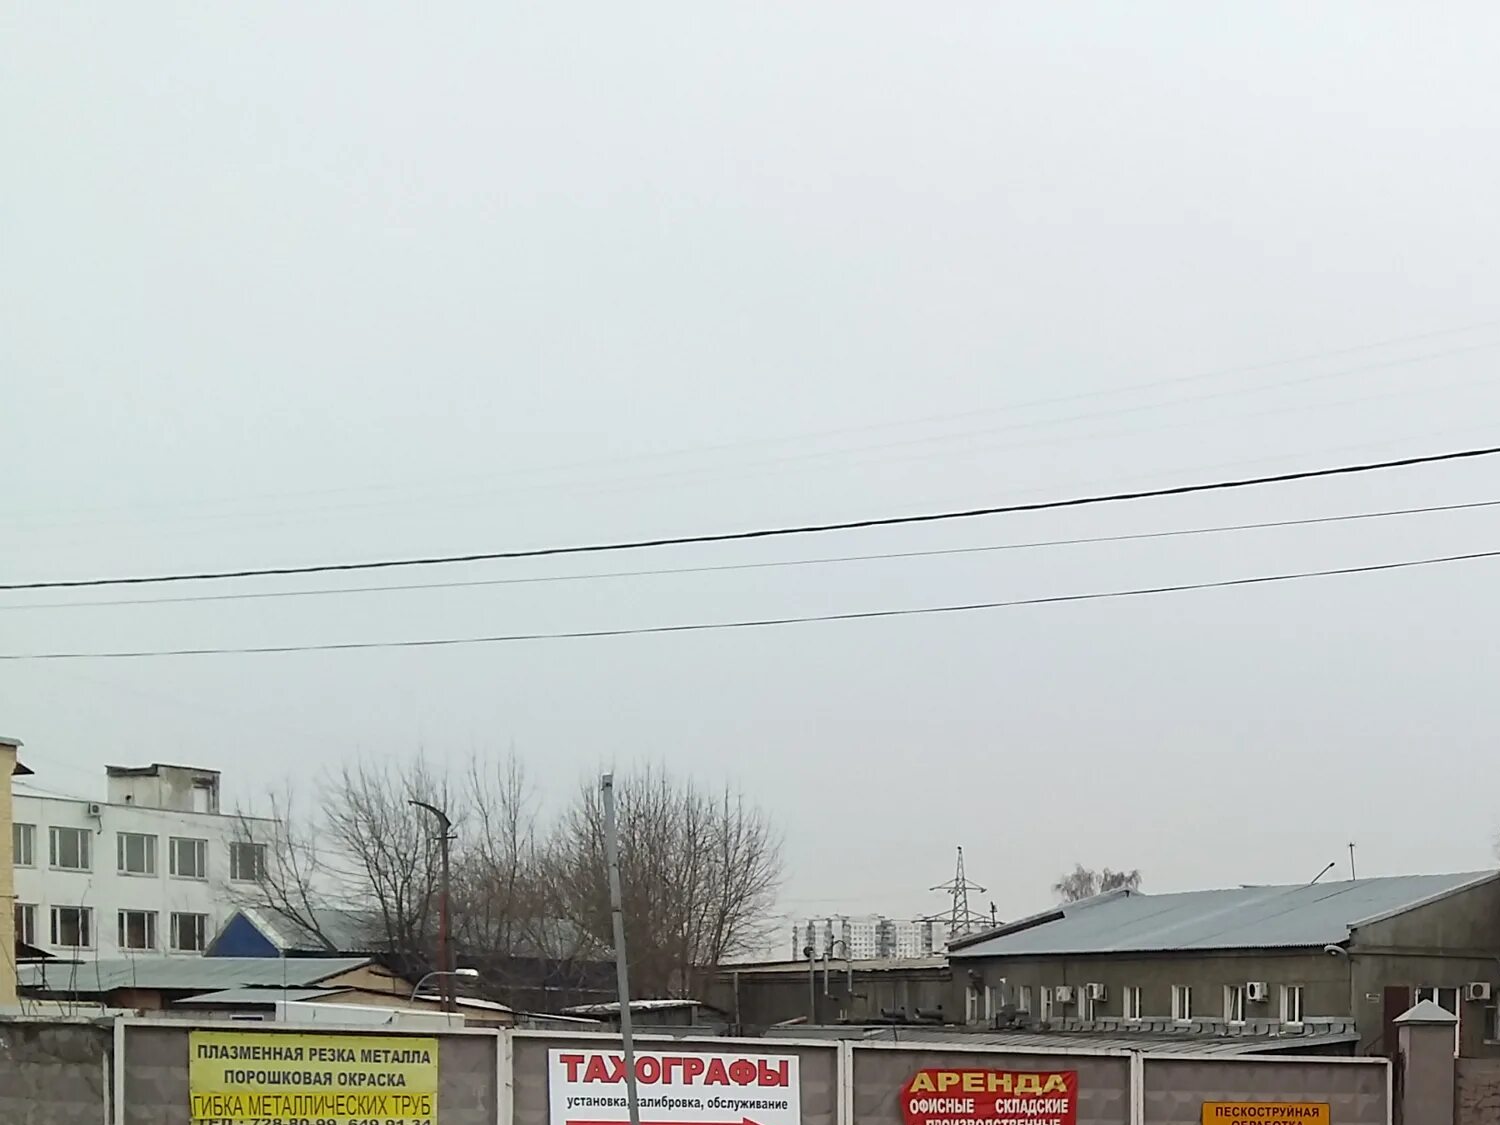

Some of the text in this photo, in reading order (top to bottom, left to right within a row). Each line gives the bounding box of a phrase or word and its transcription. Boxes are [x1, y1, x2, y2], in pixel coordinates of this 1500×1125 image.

[197, 1044, 431, 1064] ПЛАЗМЕННАЯ РЕЗКА МЕТАЛЛА
[224, 1070, 406, 1087] ПОРОШКОВАЯ ОКРАСКА
[909, 1072, 1068, 1096] АРЕНДА
[193, 1095, 431, 1116] ГИБКА МЕТАЛЛИЧЕСКИХ ТРУБ
[567, 1095, 630, 1109] установка,
[707, 1096, 788, 1110] обслуживание
[909, 1098, 1069, 1117] ОФИСНЫЕ СКЛАДСКИЕ
[1215, 1105, 1319, 1117] ПЕСКОСТРУЙНАЯ
